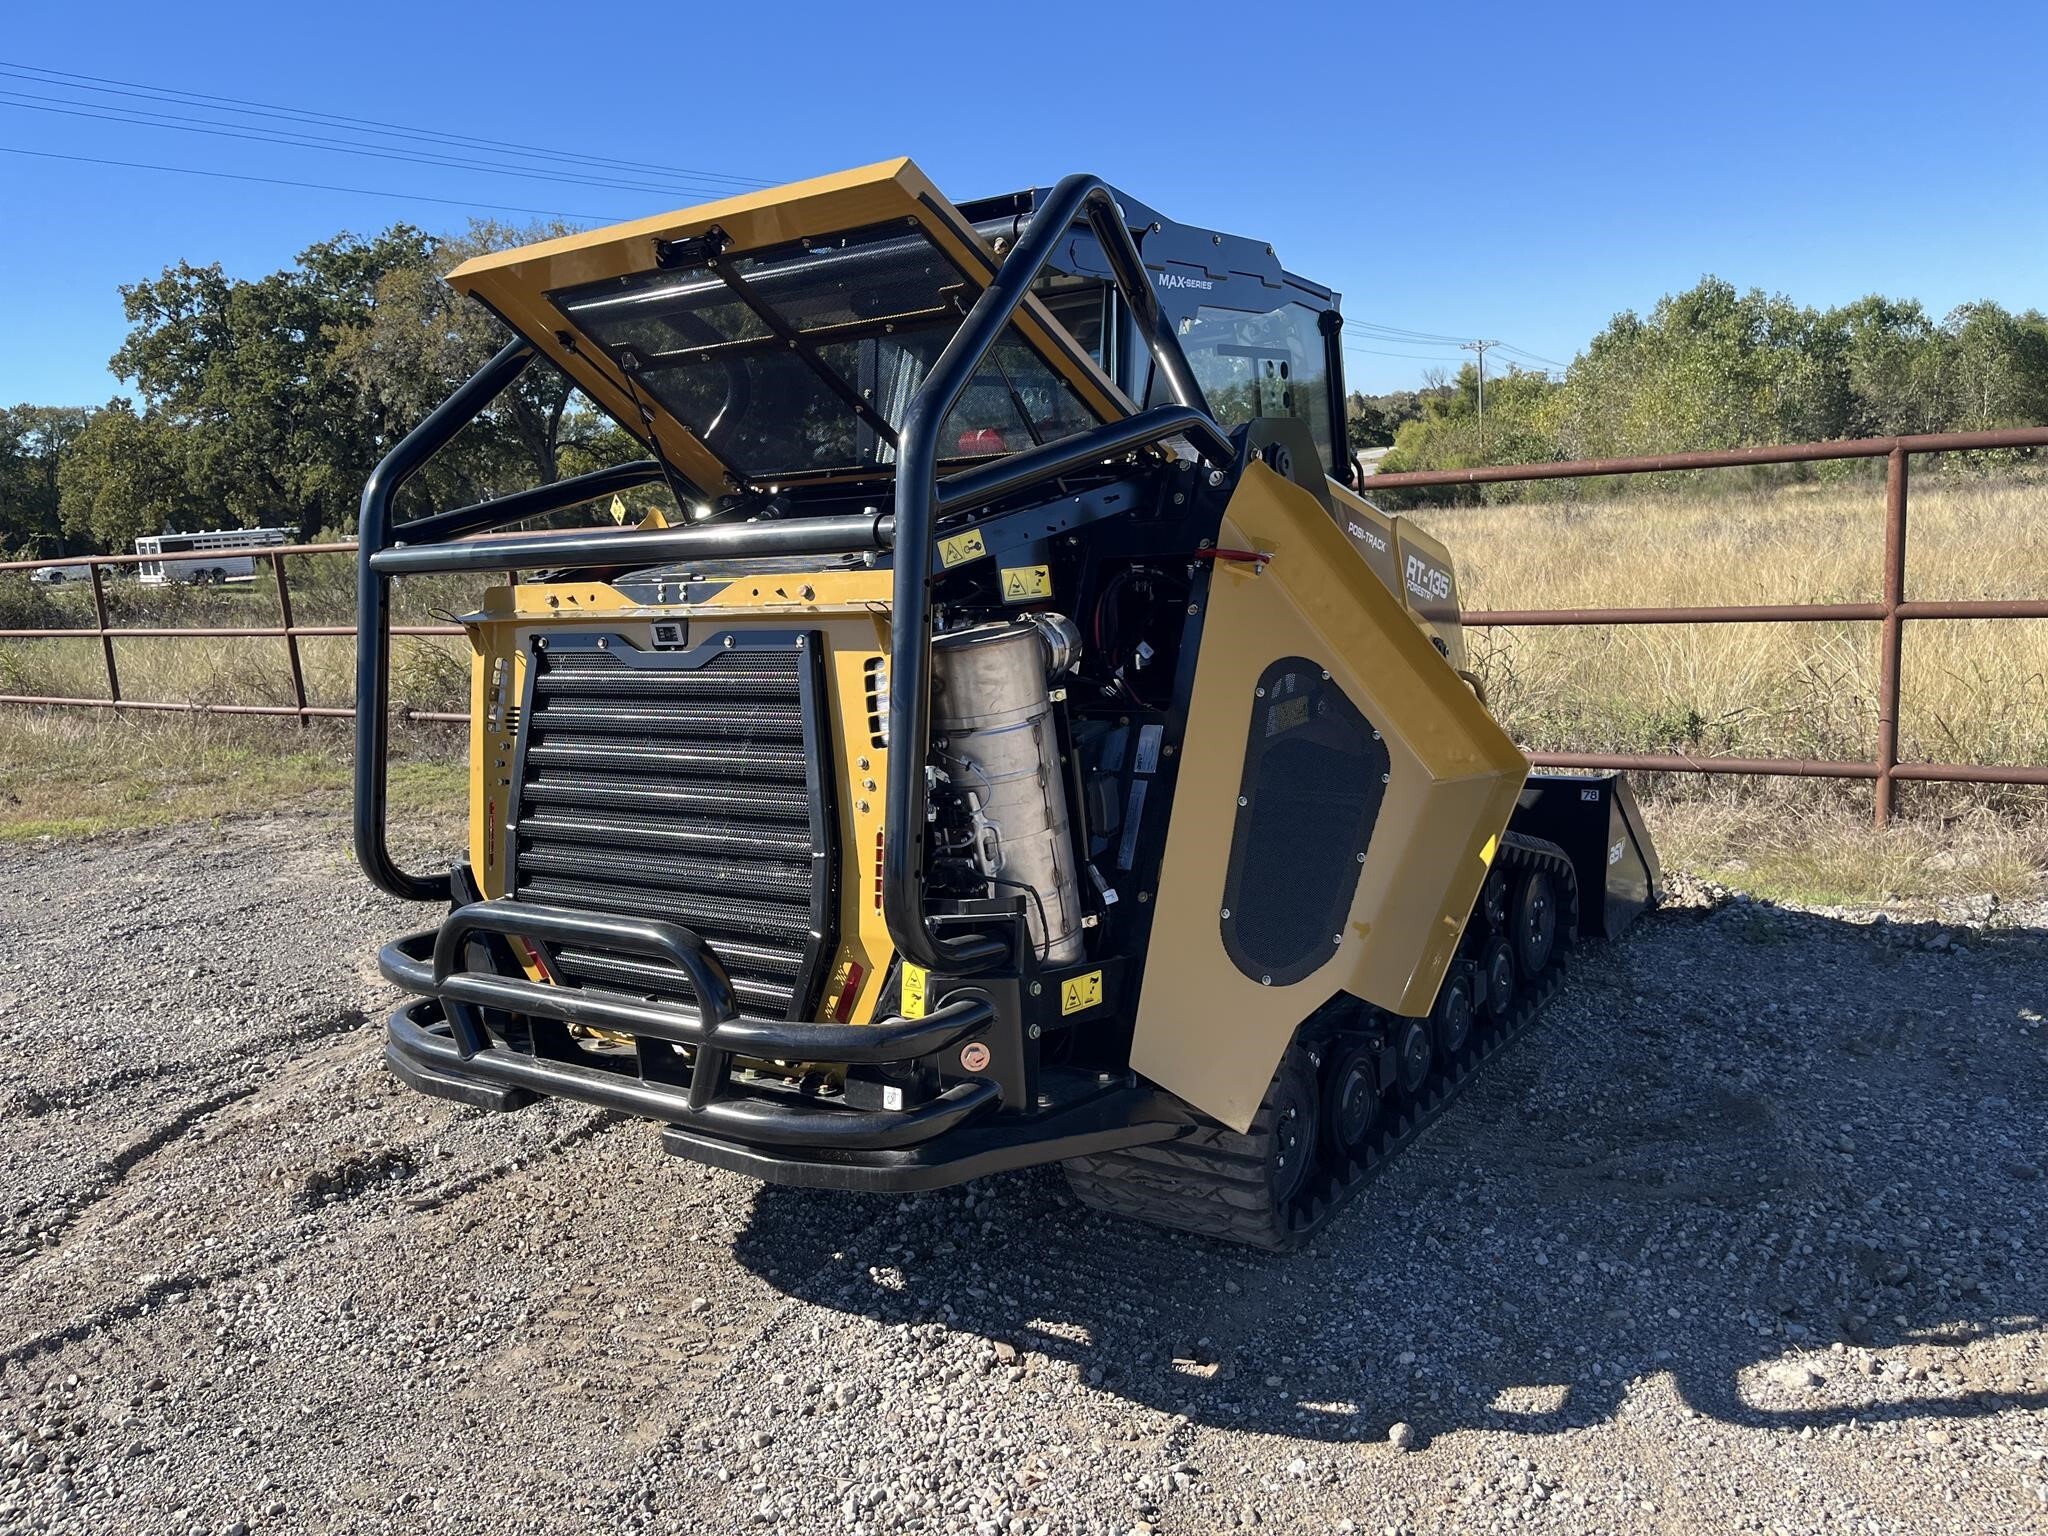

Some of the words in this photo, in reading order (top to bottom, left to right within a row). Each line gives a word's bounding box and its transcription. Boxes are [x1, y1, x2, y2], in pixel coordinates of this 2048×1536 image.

[1348, 521, 1387, 552] POSI-TRACK
[1406, 554, 1450, 600] RT-135
[1406, 579, 1435, 602] FORESTRY
[1583, 790, 1598, 800] 78
